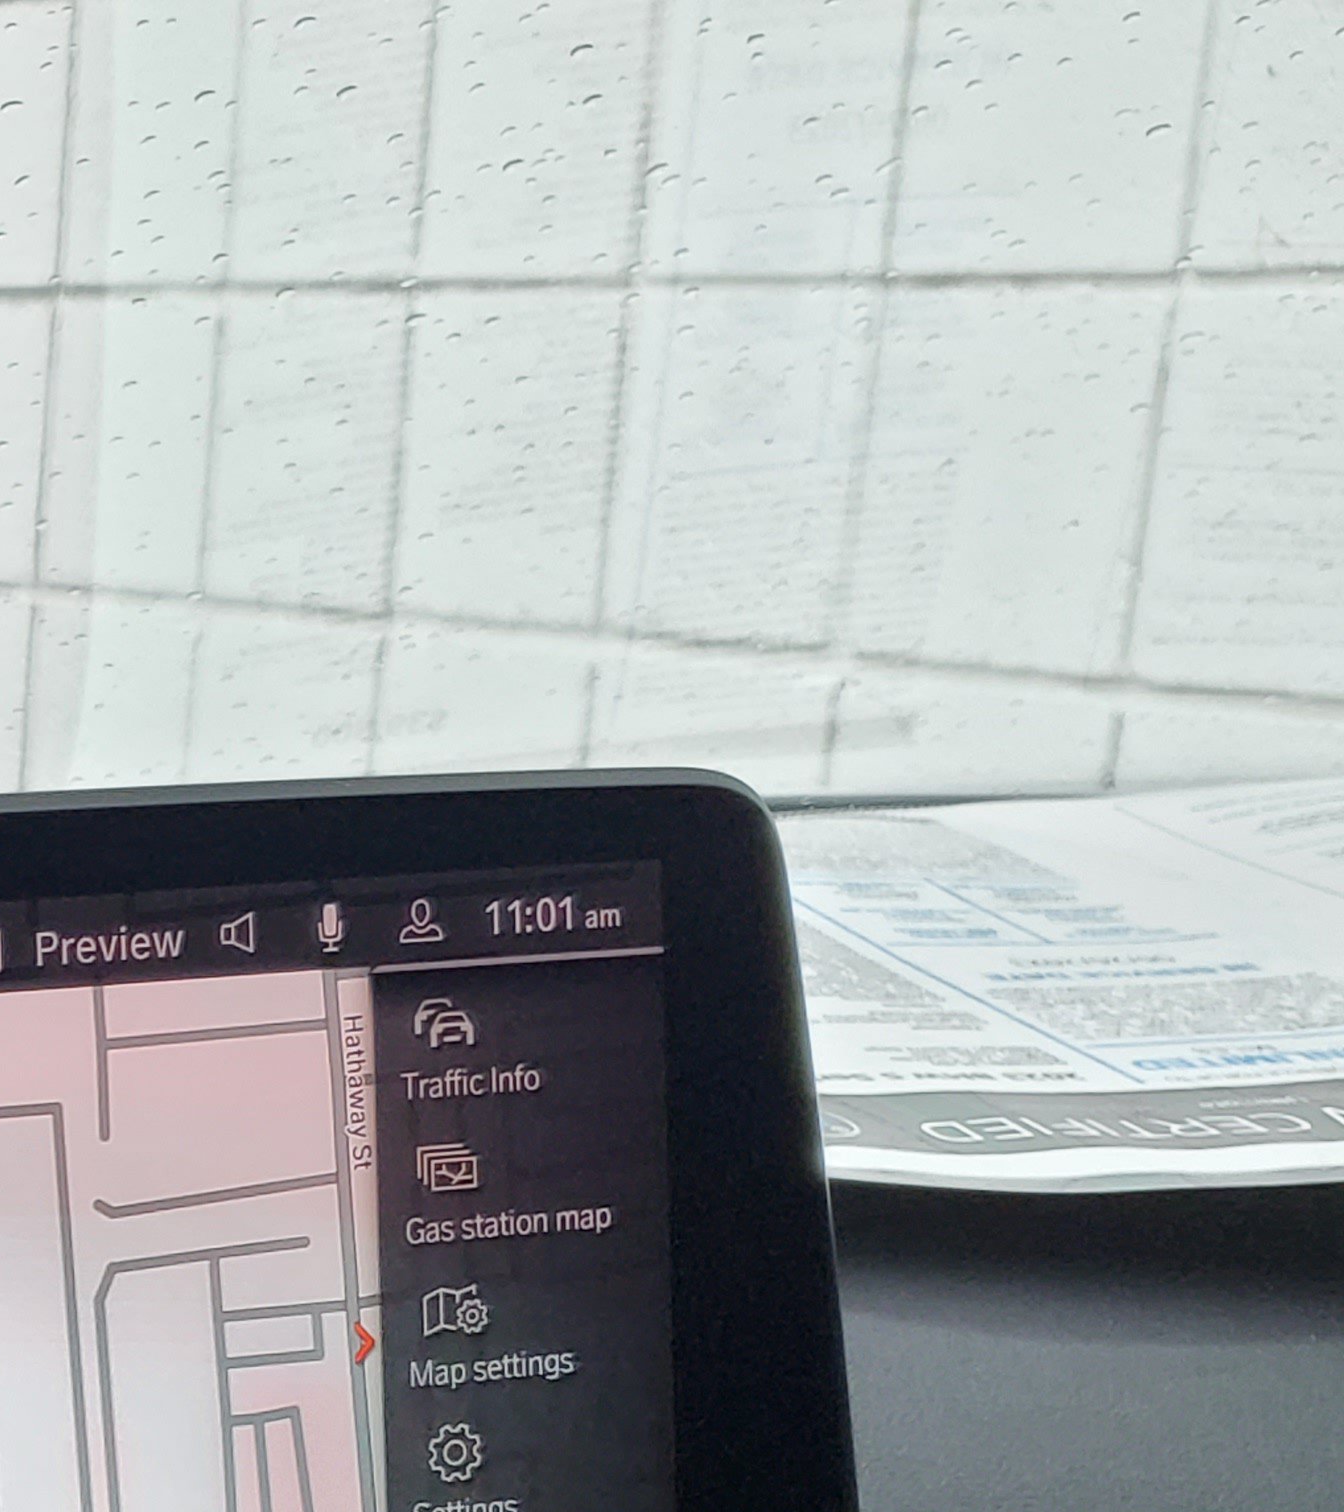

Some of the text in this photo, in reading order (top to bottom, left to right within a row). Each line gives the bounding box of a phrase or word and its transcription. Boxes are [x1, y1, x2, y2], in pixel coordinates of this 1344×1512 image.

[485, 896, 622, 935] 11:01 am
[35, 926, 184, 967] Preview
[343, 1015, 372, 1171] Hathaway St
[399, 1062, 541, 1100] Traffic Info
[919, 1110, 1312, 1145] CERTIFIED
[406, 1206, 612, 1245] Gas station map
[409, 1351, 576, 1390] Map settings
